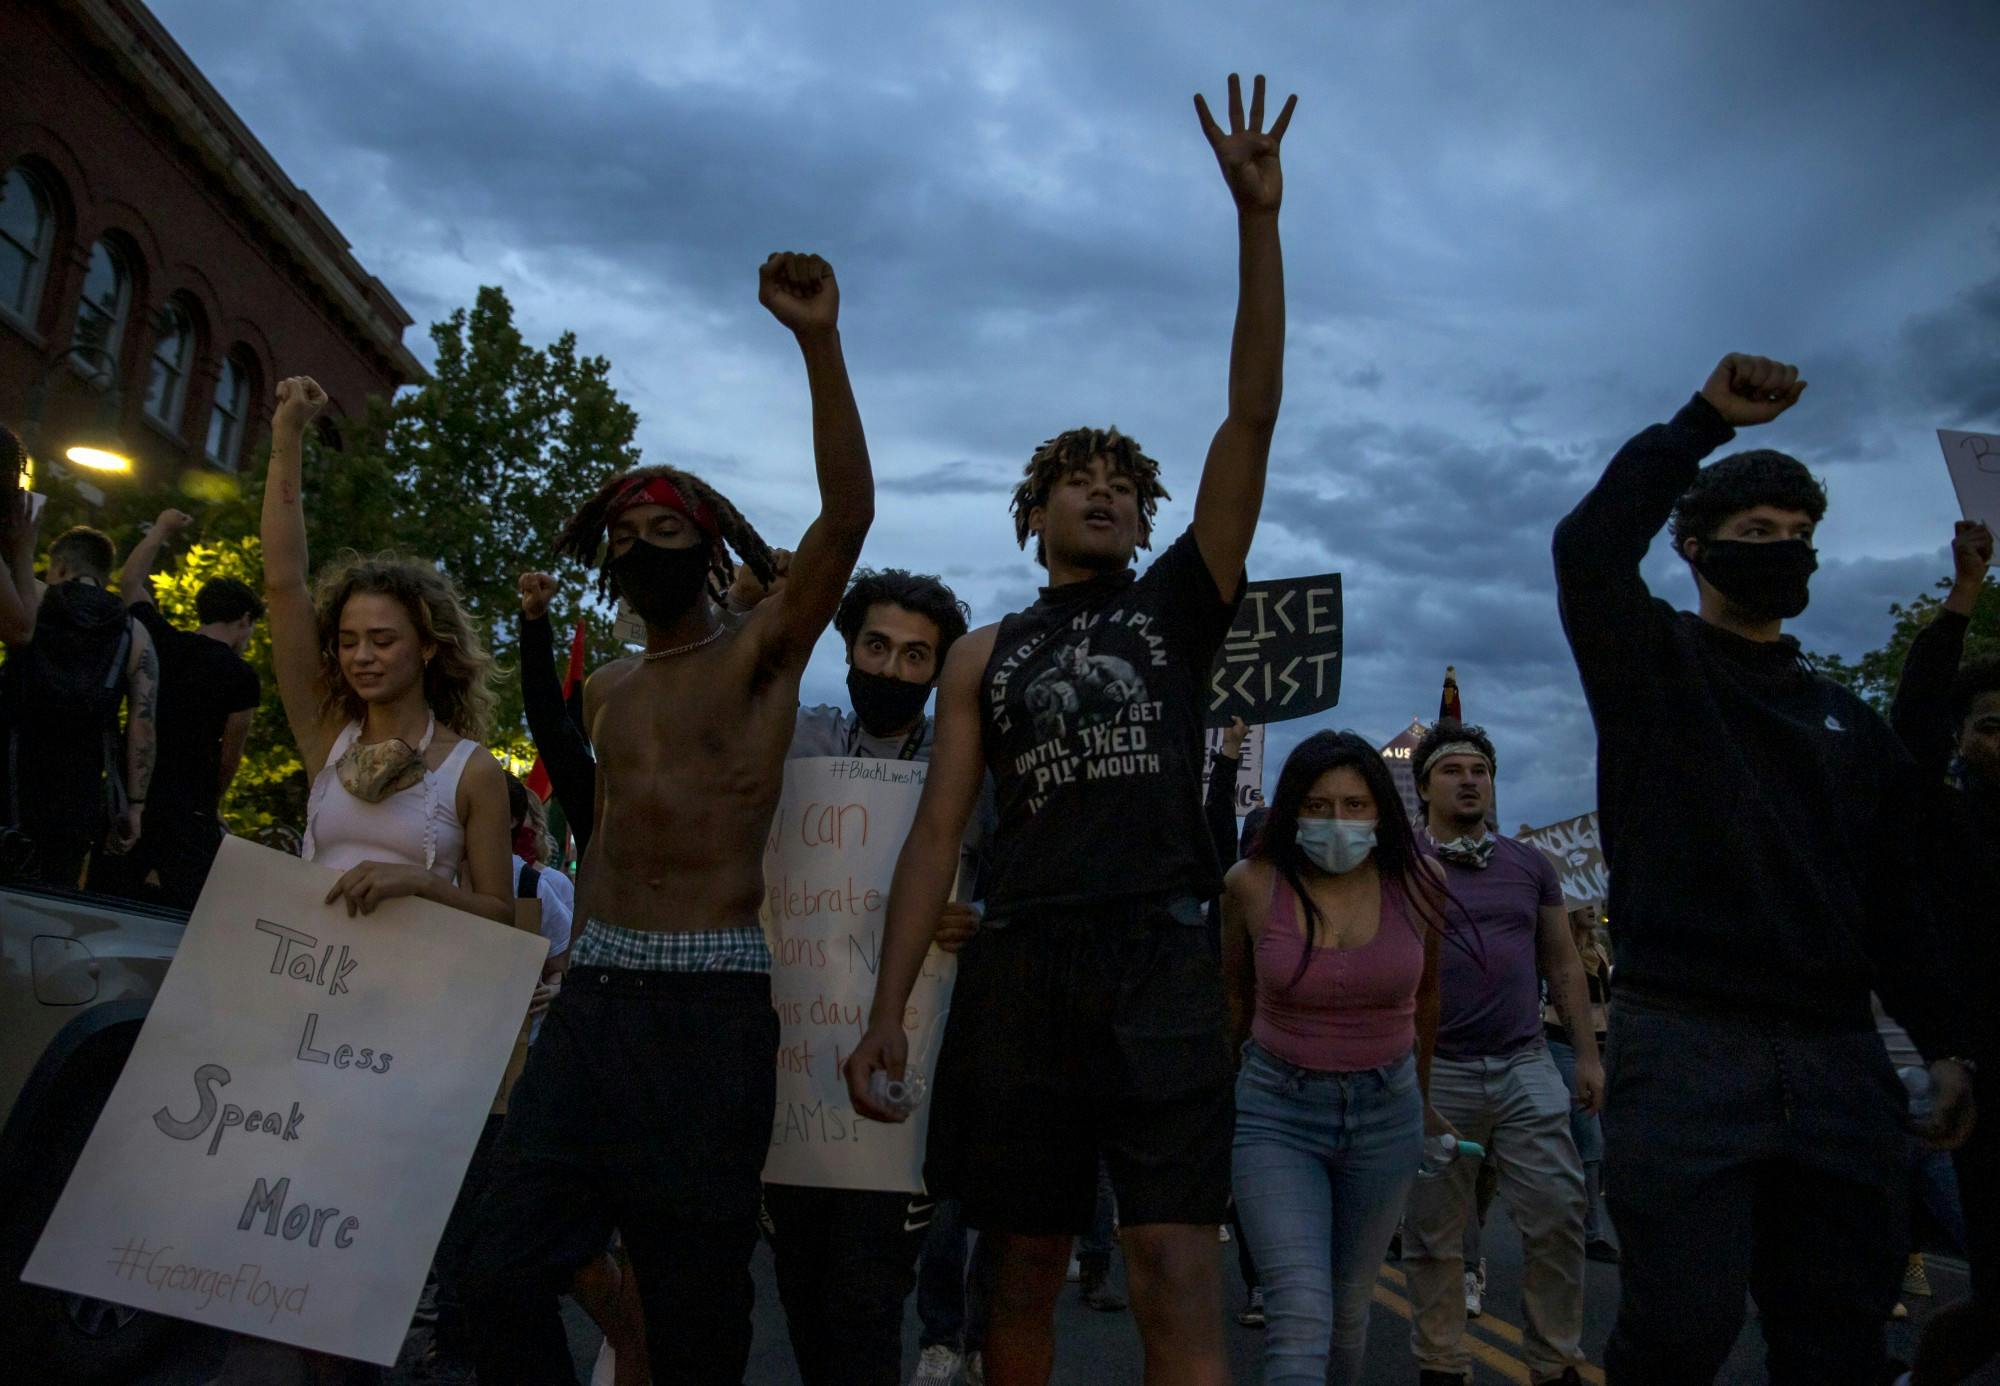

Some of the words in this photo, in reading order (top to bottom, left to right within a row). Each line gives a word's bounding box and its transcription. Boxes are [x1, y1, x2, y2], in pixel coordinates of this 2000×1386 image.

[1126, 611, 1168, 667] PLAN
[1226, 588, 1337, 640] LICE
[1209, 651, 1337, 711] SCIST
[1015, 737, 1071, 776] UNTIL
[1129, 700, 1164, 722] GET
[1086, 753, 1160, 780] MOUTH
[802, 802, 867, 849] can
[255, 918, 358, 996] Talk
[296, 1012, 393, 1074] Less
[773, 992, 802, 1026] his
[810, 993, 865, 1038] day
[151, 1063, 305, 1156] Speak
[236, 1177, 360, 1249] More
[106, 1236, 310, 1323] #GeorgeFloyd
